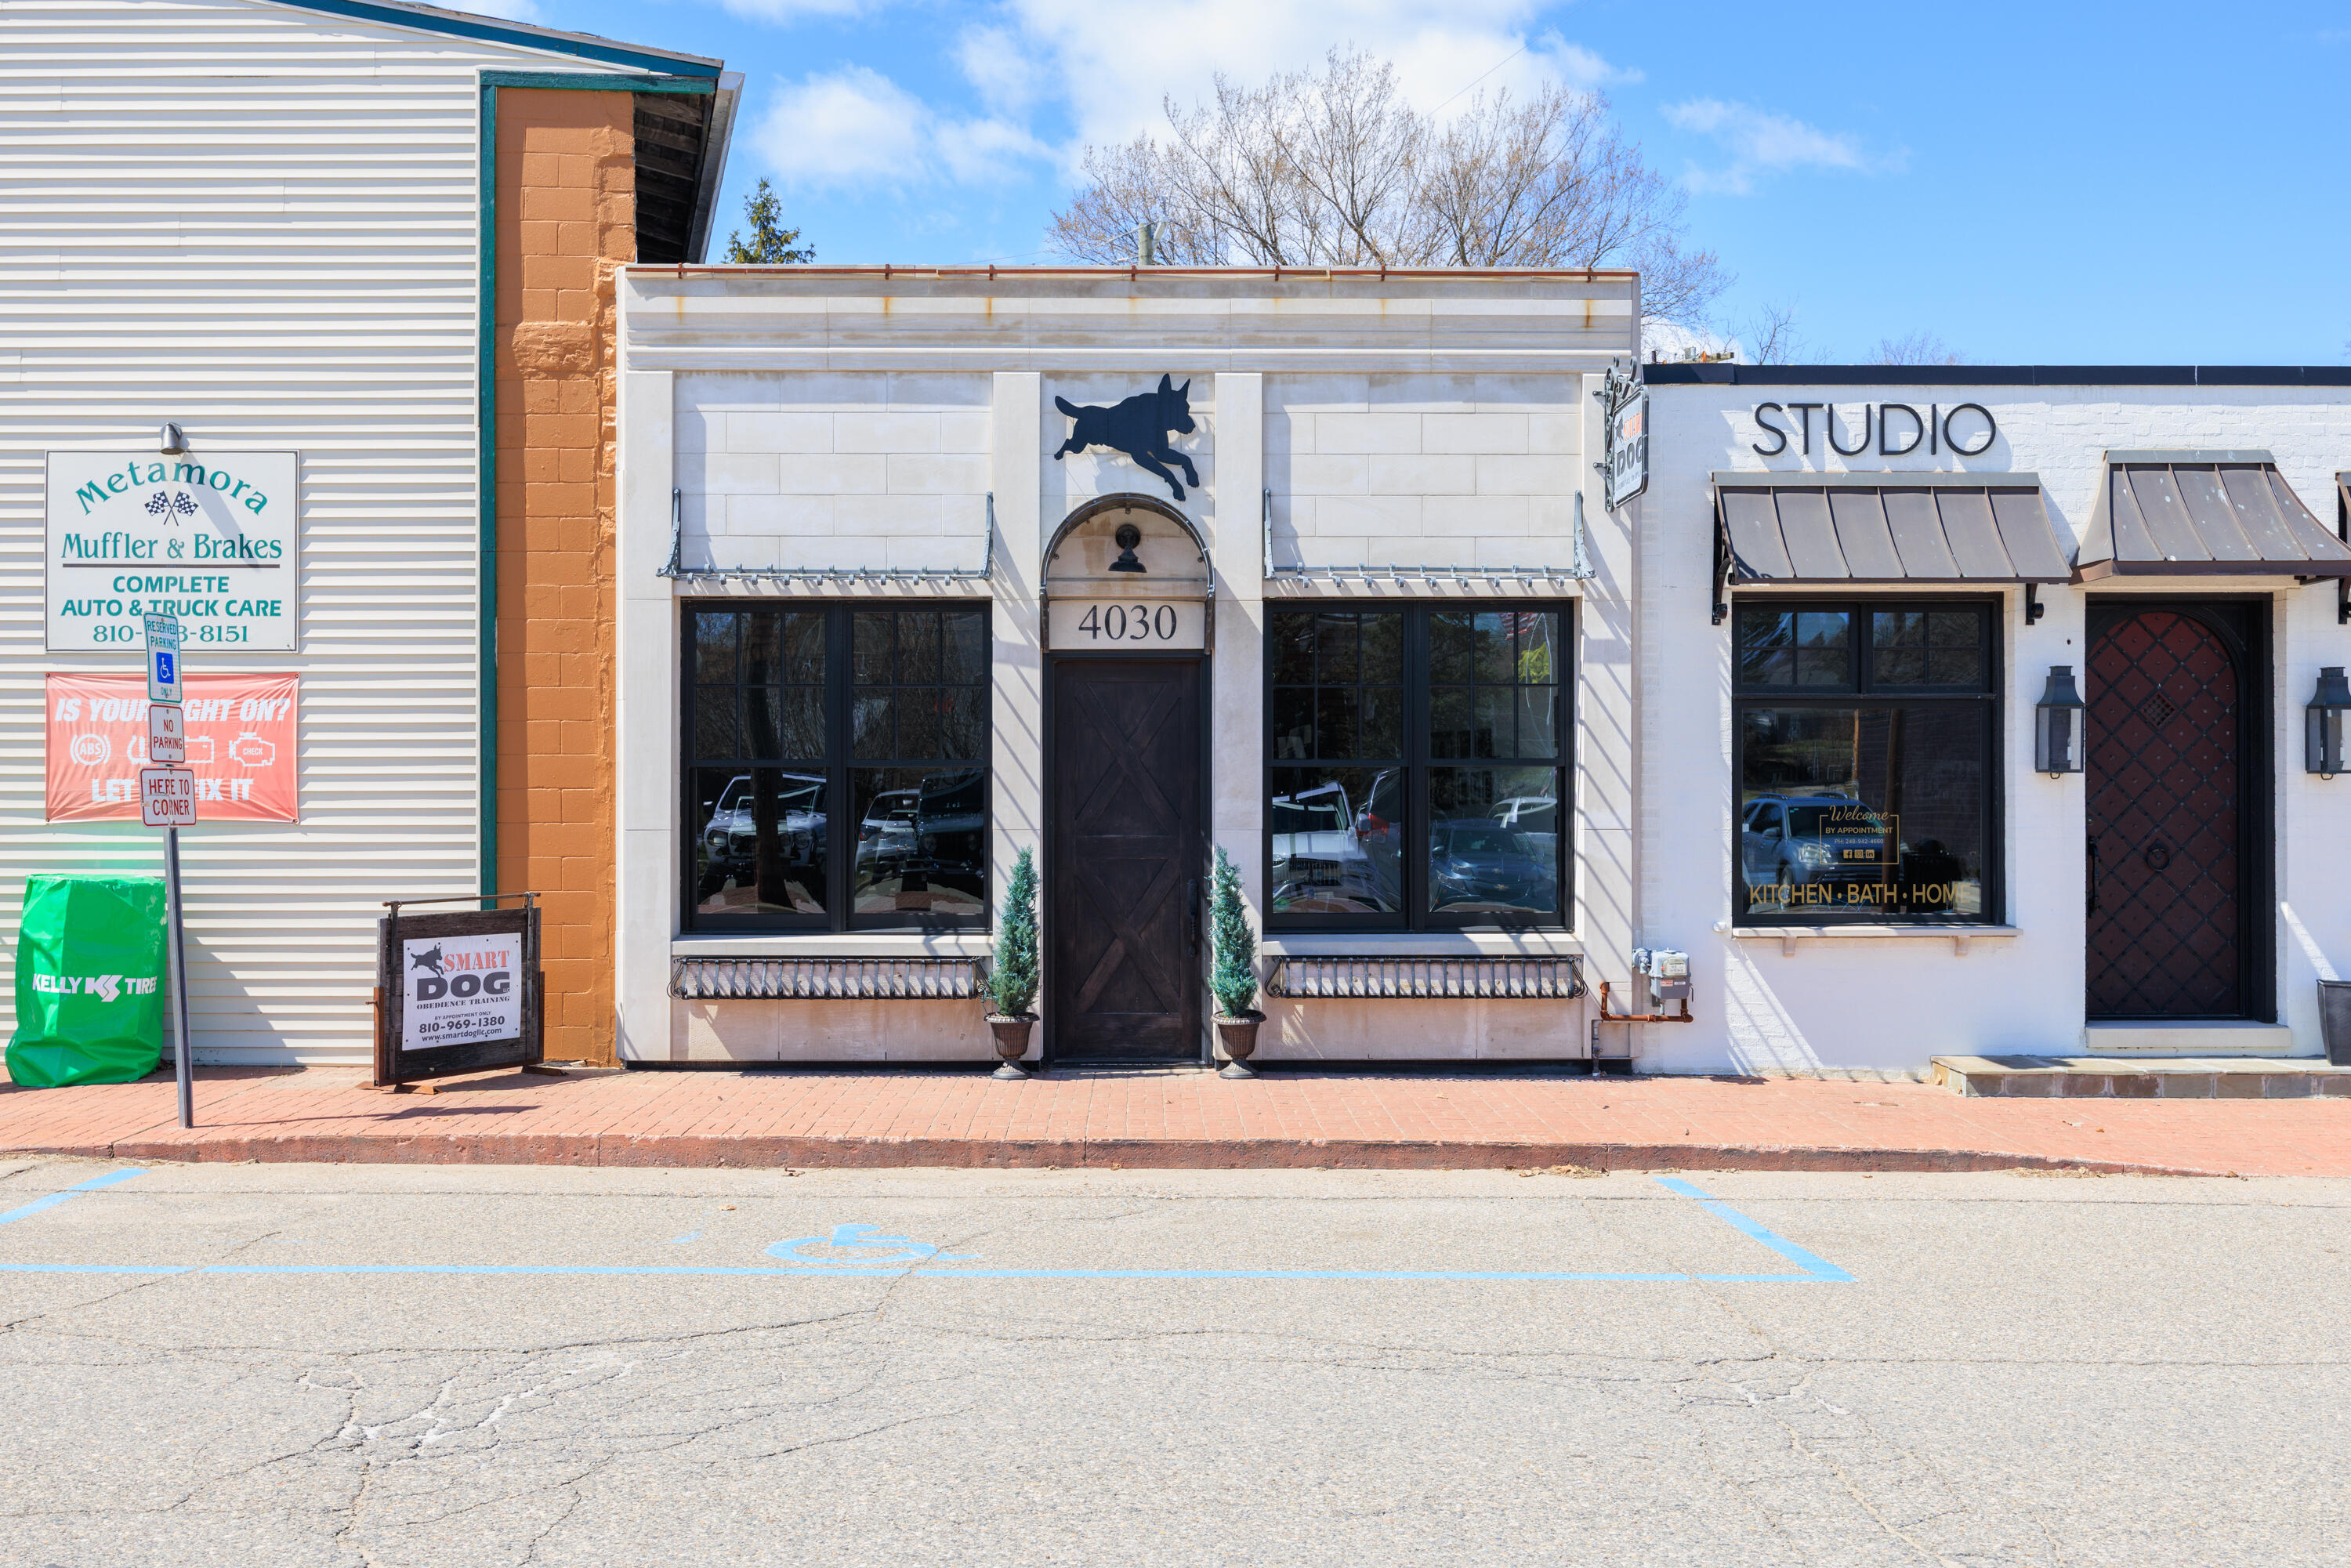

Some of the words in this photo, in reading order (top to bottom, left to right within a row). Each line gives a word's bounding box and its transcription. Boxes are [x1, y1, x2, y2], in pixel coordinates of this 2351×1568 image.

[1752, 402, 1997, 456] STUDIO
[1617, 436, 1643, 477] DOG
[74, 460, 268, 516] Metamora
[61, 532, 158, 559] Muffler
[167, 539, 185, 559] &
[194, 533, 282, 559] Brakes
[113, 576, 230, 593] COMPLETE
[60, 599, 123, 617] AUTO
[129, 599, 143, 617] &
[149, 599, 220, 617] TRUCK
[225, 599, 282, 617] CARE
[147, 621, 176, 636] RESERVED
[1078, 605, 1177, 640] 4030
[150, 636, 176, 650] PARKING
[160, 686, 172, 697] ONLY
[55, 697, 82, 721] IS
[240, 697, 292, 722] ON?
[163, 719, 174, 732] NO
[80, 743, 101, 755] ABS
[154, 736, 182, 751] PARKING
[243, 747, 263, 756] CHECK
[149, 779, 176, 795] HERE
[179, 779, 190, 795] TO
[231, 778, 254, 801] IT
[152, 799, 190, 816] CORNER
[1829, 805, 1889, 821] Welcome
[1750, 884, 1832, 904] KITCHEN
[1848, 884, 1896, 904] BATH
[1913, 884, 1972, 904] HOME
[444, 950, 509, 972] SMART
[32, 973, 83, 994] KELLY
[125, 976, 158, 995] TIRES
[417, 972, 510, 1001] DOG
[417, 1000, 466, 1010] OBEDIENCE
[469, 996, 510, 1005] TRAINING
[442, 1012, 478, 1020] APPOINTMENT
[419, 1016, 505, 1034] 810-969-1380
[422, 1027, 502, 1041] www.smartdogllc.com
